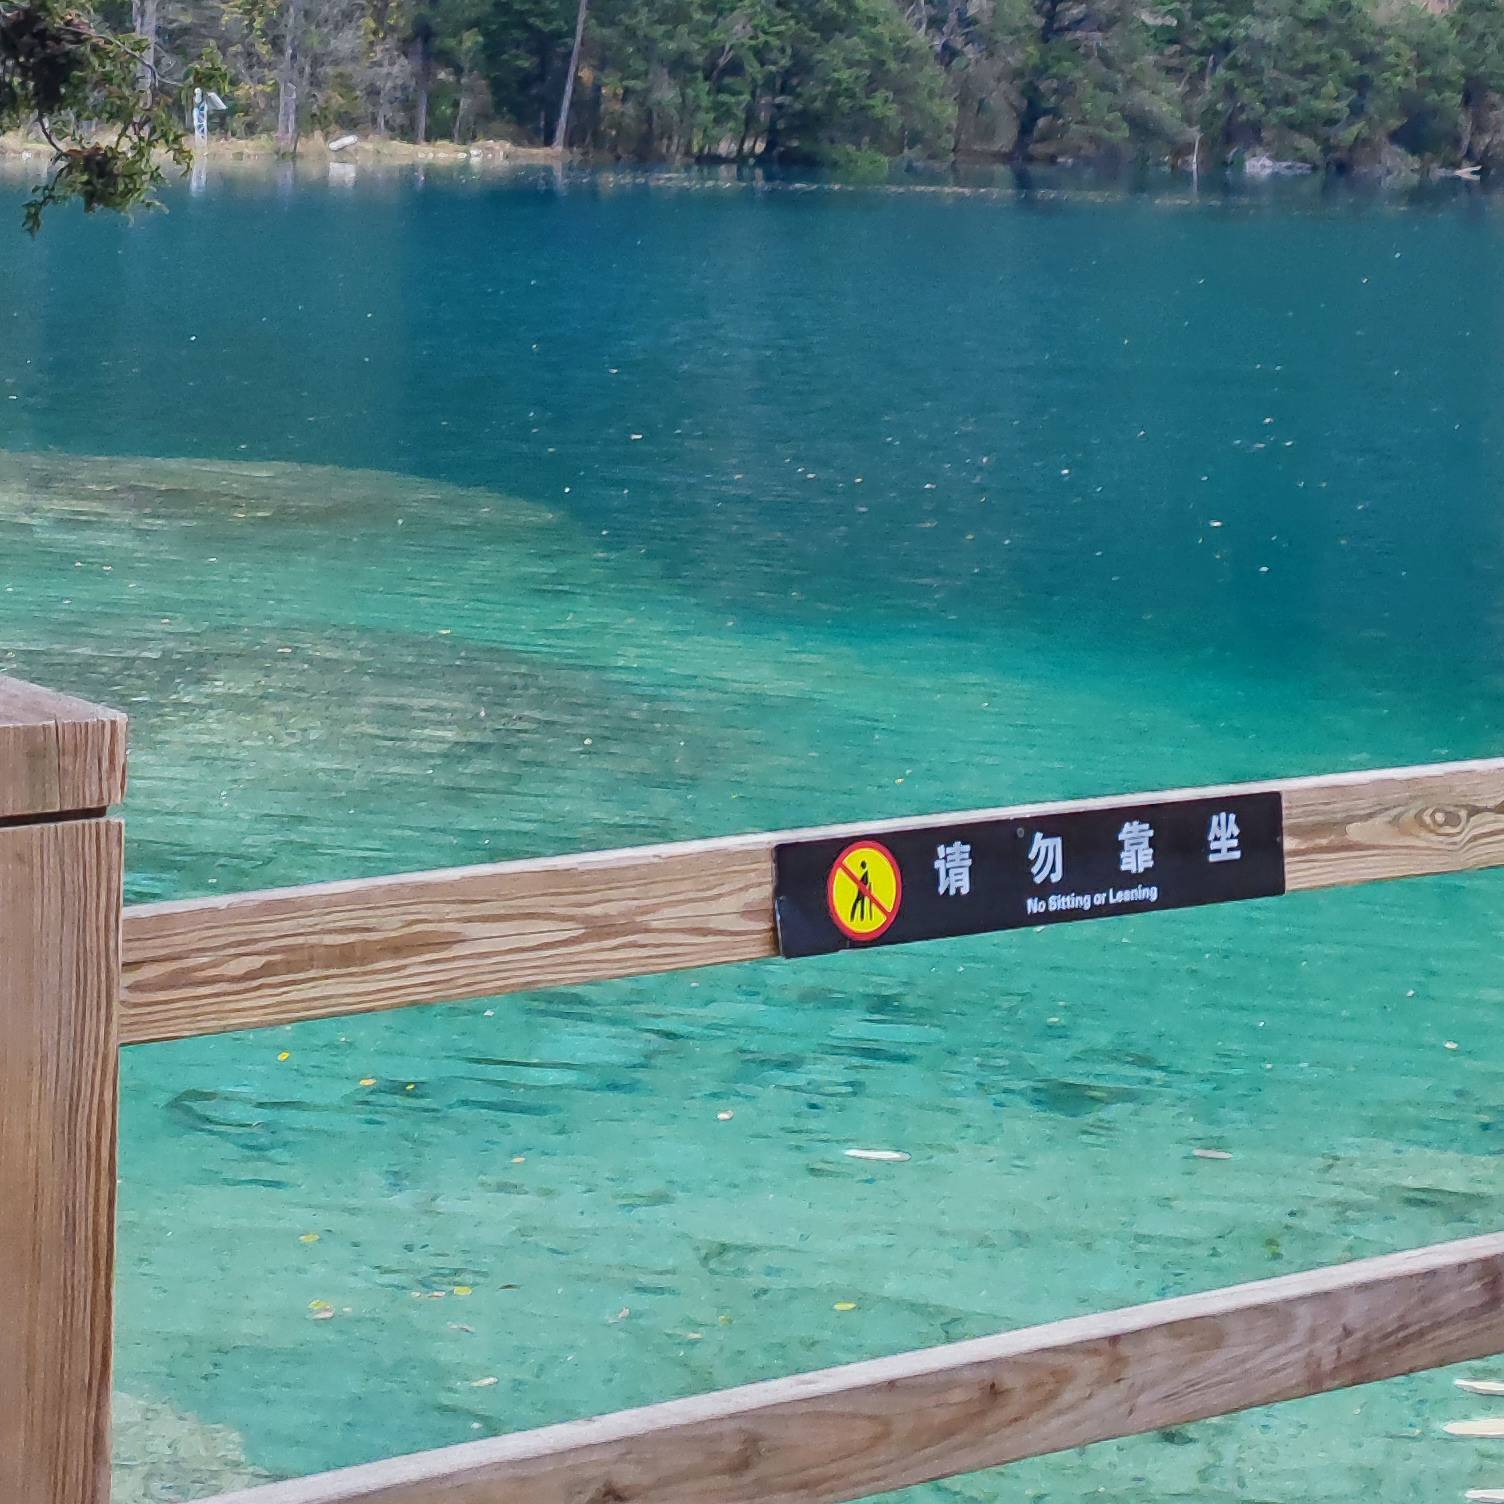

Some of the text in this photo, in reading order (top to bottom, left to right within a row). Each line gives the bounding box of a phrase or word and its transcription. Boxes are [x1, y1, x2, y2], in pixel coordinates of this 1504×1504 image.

[933, 810, 1243, 897] 请勿靠坐
[1026, 884, 1159, 915] No Sitting or Leaning
